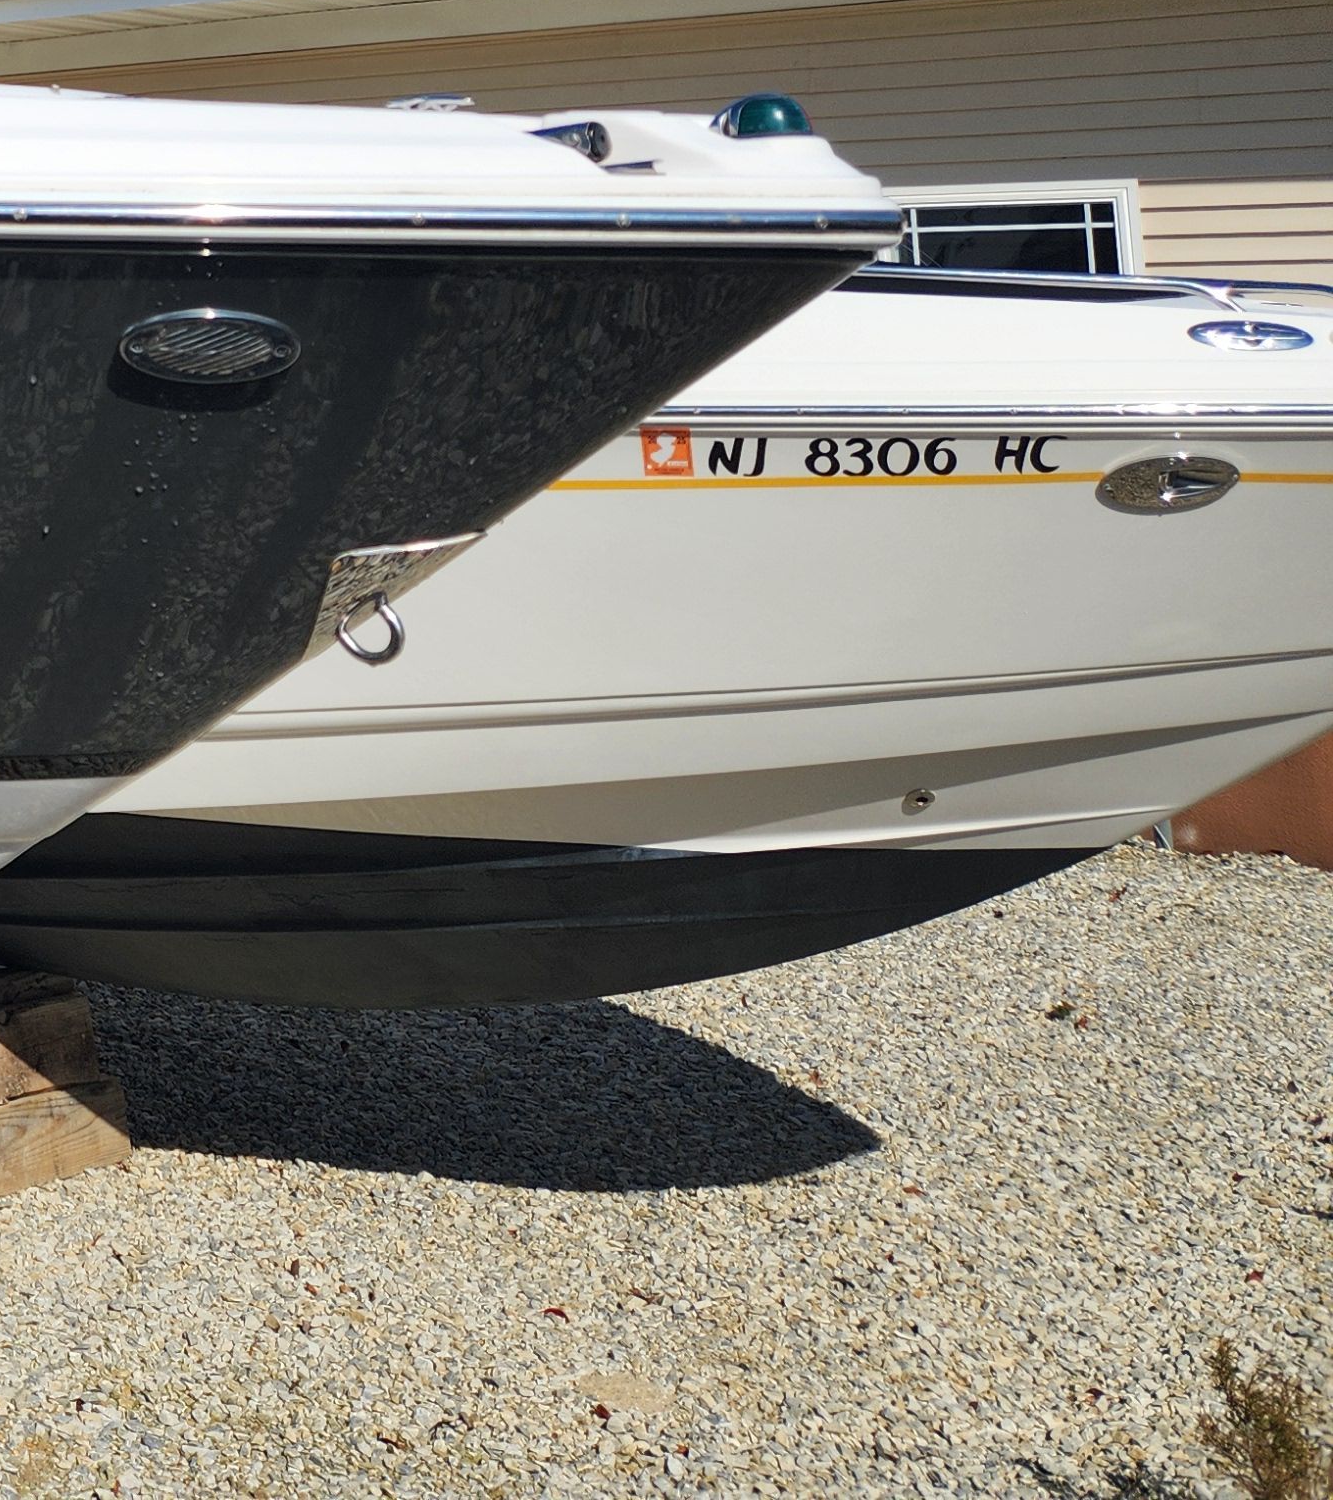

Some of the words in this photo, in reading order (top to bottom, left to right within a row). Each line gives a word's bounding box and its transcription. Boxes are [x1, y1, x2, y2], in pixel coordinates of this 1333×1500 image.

[708, 437, 768, 477] NJ
[804, 437, 958, 477] 8306
[994, 435, 1069, 474] HC
